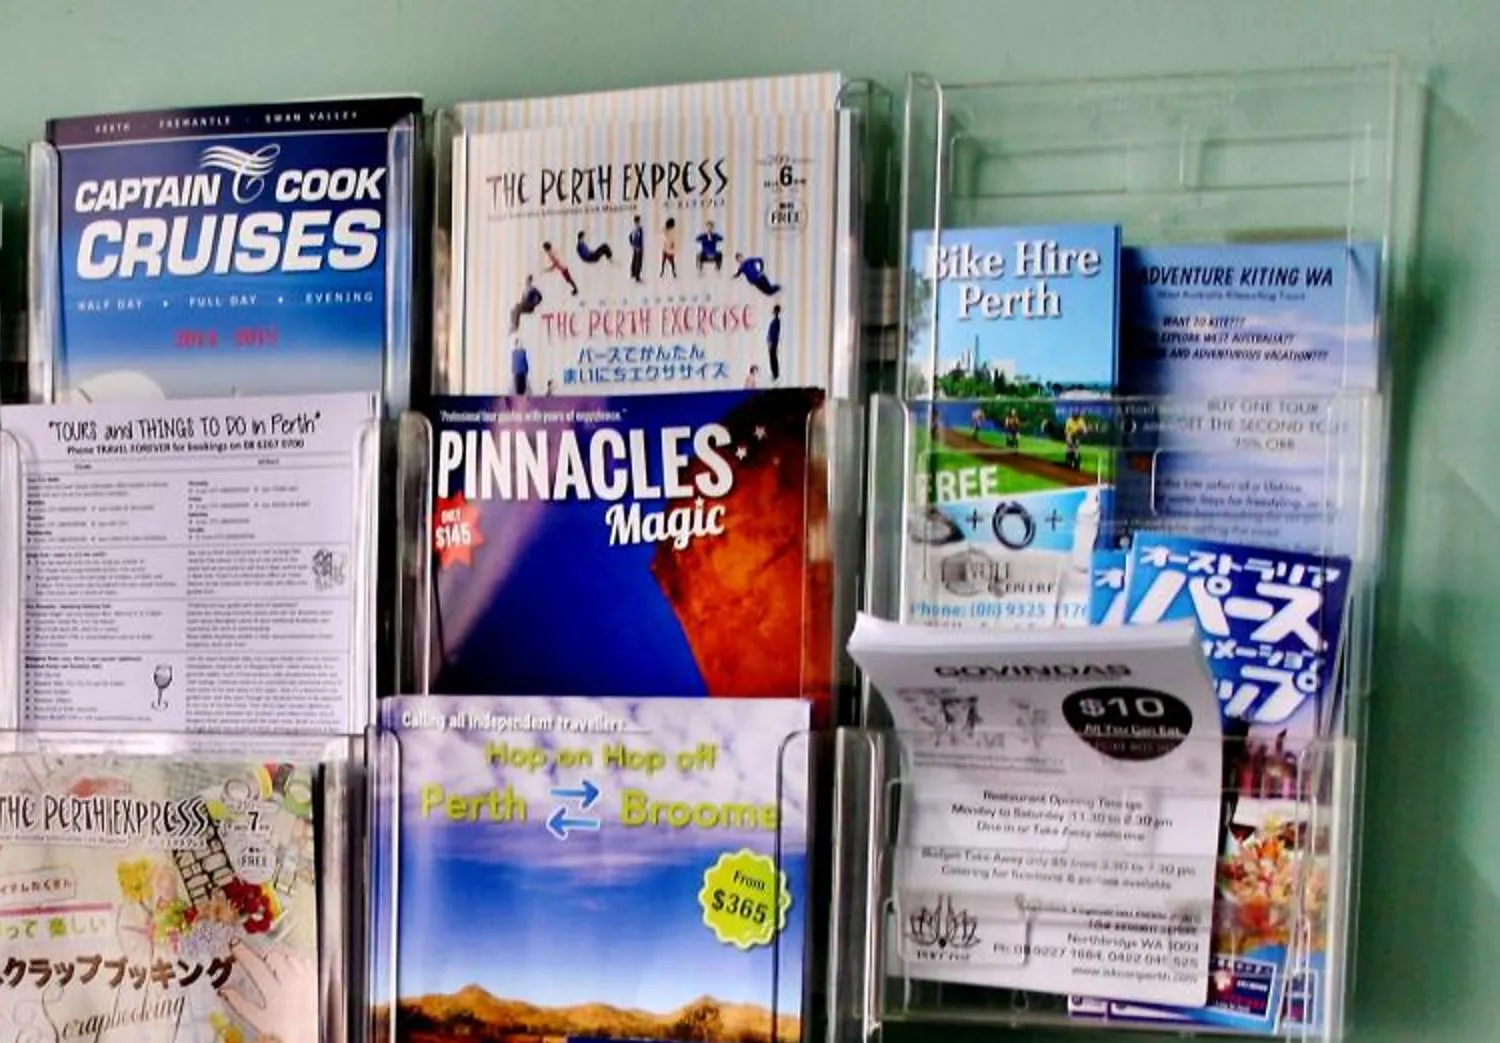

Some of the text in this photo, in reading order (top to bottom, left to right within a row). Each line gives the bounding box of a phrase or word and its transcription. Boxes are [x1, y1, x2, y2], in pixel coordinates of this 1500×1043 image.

[75, 167, 386, 212] CAPTAIN COOK
[487, 158, 729, 209] THE PERTH EXPRESS
[779, 166, 793, 187] 6
[77, 209, 382, 280] CRUISES
[924, 239, 1101, 280] Bike Hire
[1241, 267, 1333, 287] KITING WA
[230, 292, 374, 306] DAY EVENING
[958, 281, 1063, 321] Perth
[542, 303, 757, 340] THE PERTH EXERCISE
[103, 420, 134, 440] and
[139, 419, 194, 440] THINGS
[200, 416, 221, 437] TO
[226, 415, 248, 436] DO
[252, 415, 266, 434] in
[438, 423, 734, 501] PINNACLES
[605, 497, 726, 550] Magic
[1140, 545, 1341, 588] オーストラリア
[1130, 570, 1328, 651] パース
[934, 663, 1132, 679] GOVINDAS
[1080, 696, 1165, 718] $10
[485, 741, 719, 773] Hop on Hop off
[45, 795, 105, 833] PERTH
[113, 795, 206, 836] EXPRESS
[248, 811, 260, 831] 7
[420, 784, 780, 830] Perth Broome
[733, 871, 766, 891] From
[711, 889, 768, 924] $365
